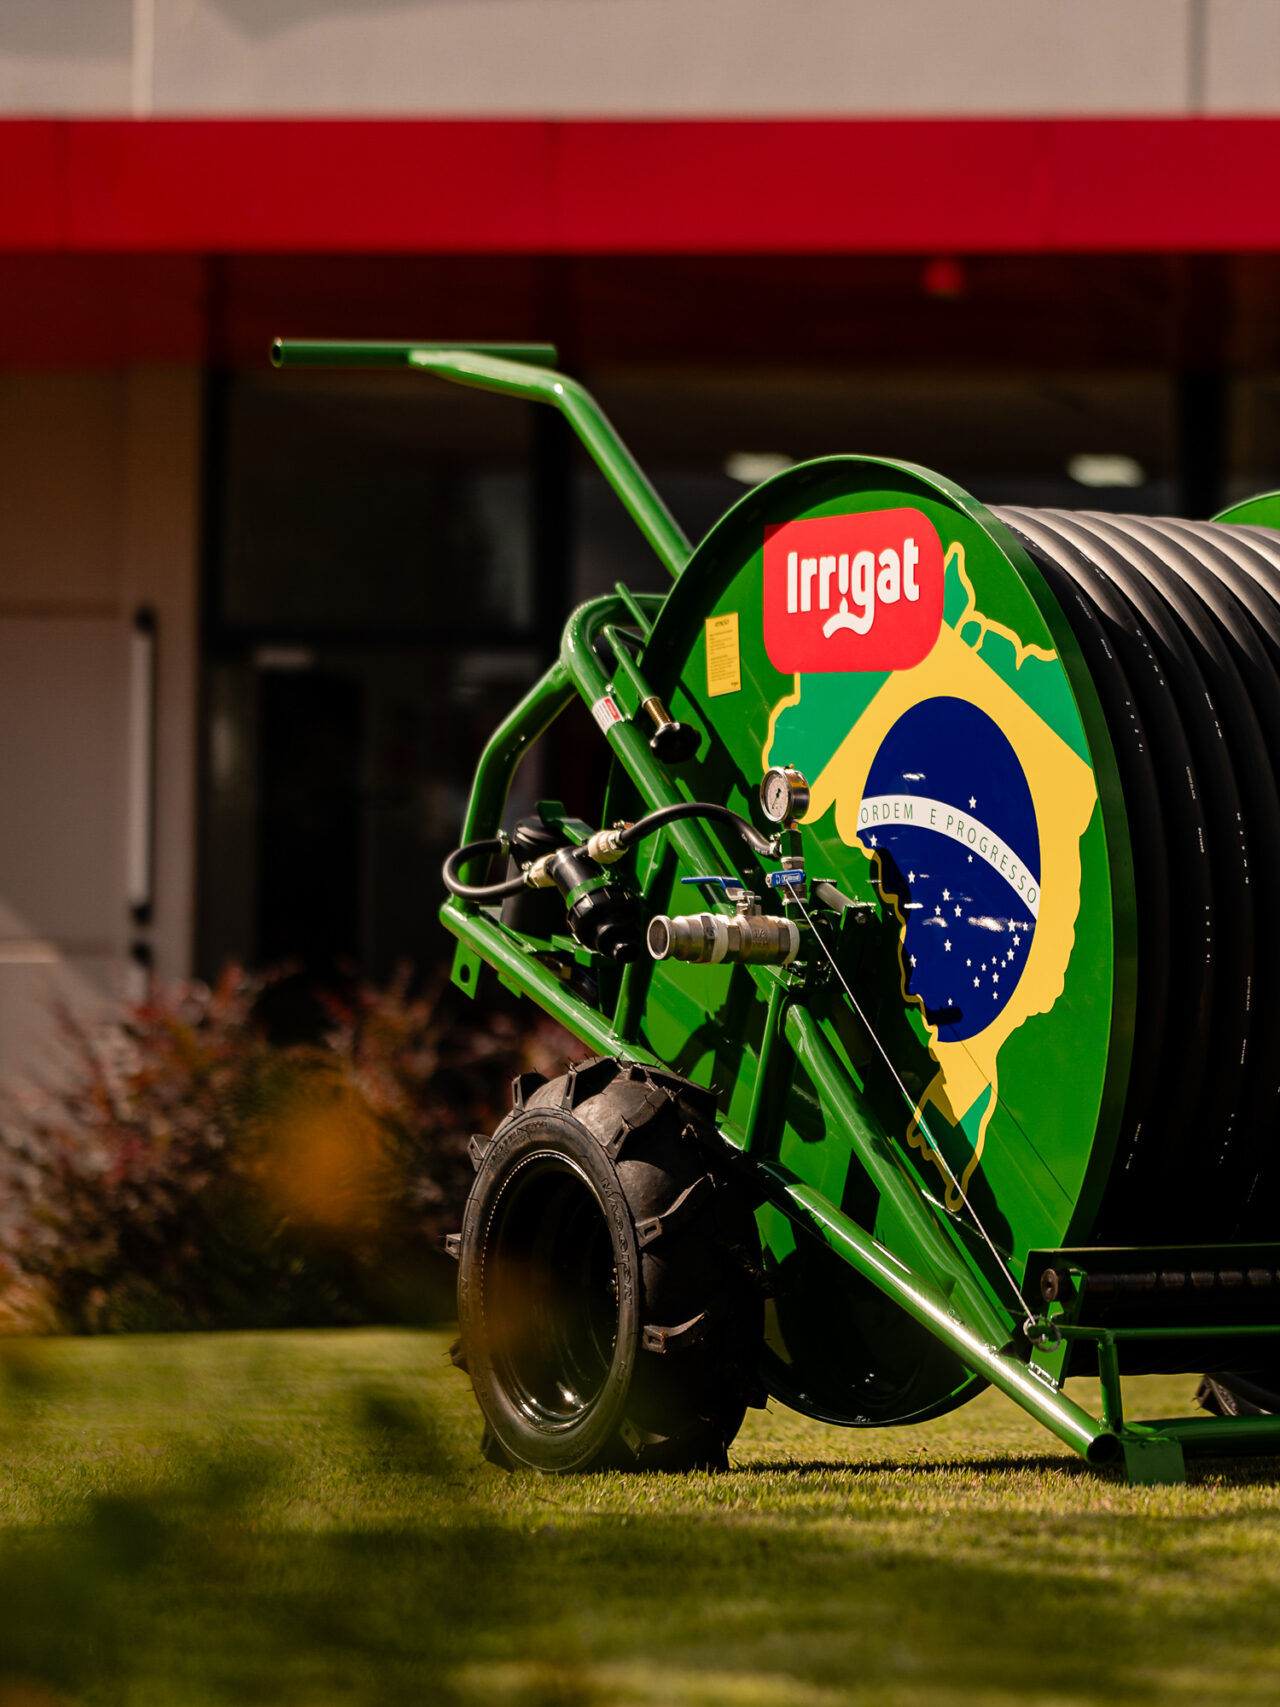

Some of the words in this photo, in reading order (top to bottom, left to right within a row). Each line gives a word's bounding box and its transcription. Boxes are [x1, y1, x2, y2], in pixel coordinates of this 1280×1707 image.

[787, 538, 920, 639] Irrigat
[860, 802, 914, 824] ORDEM
[930, 808, 937, 825] E
[946, 815, 1037, 904] PROGRESSO
